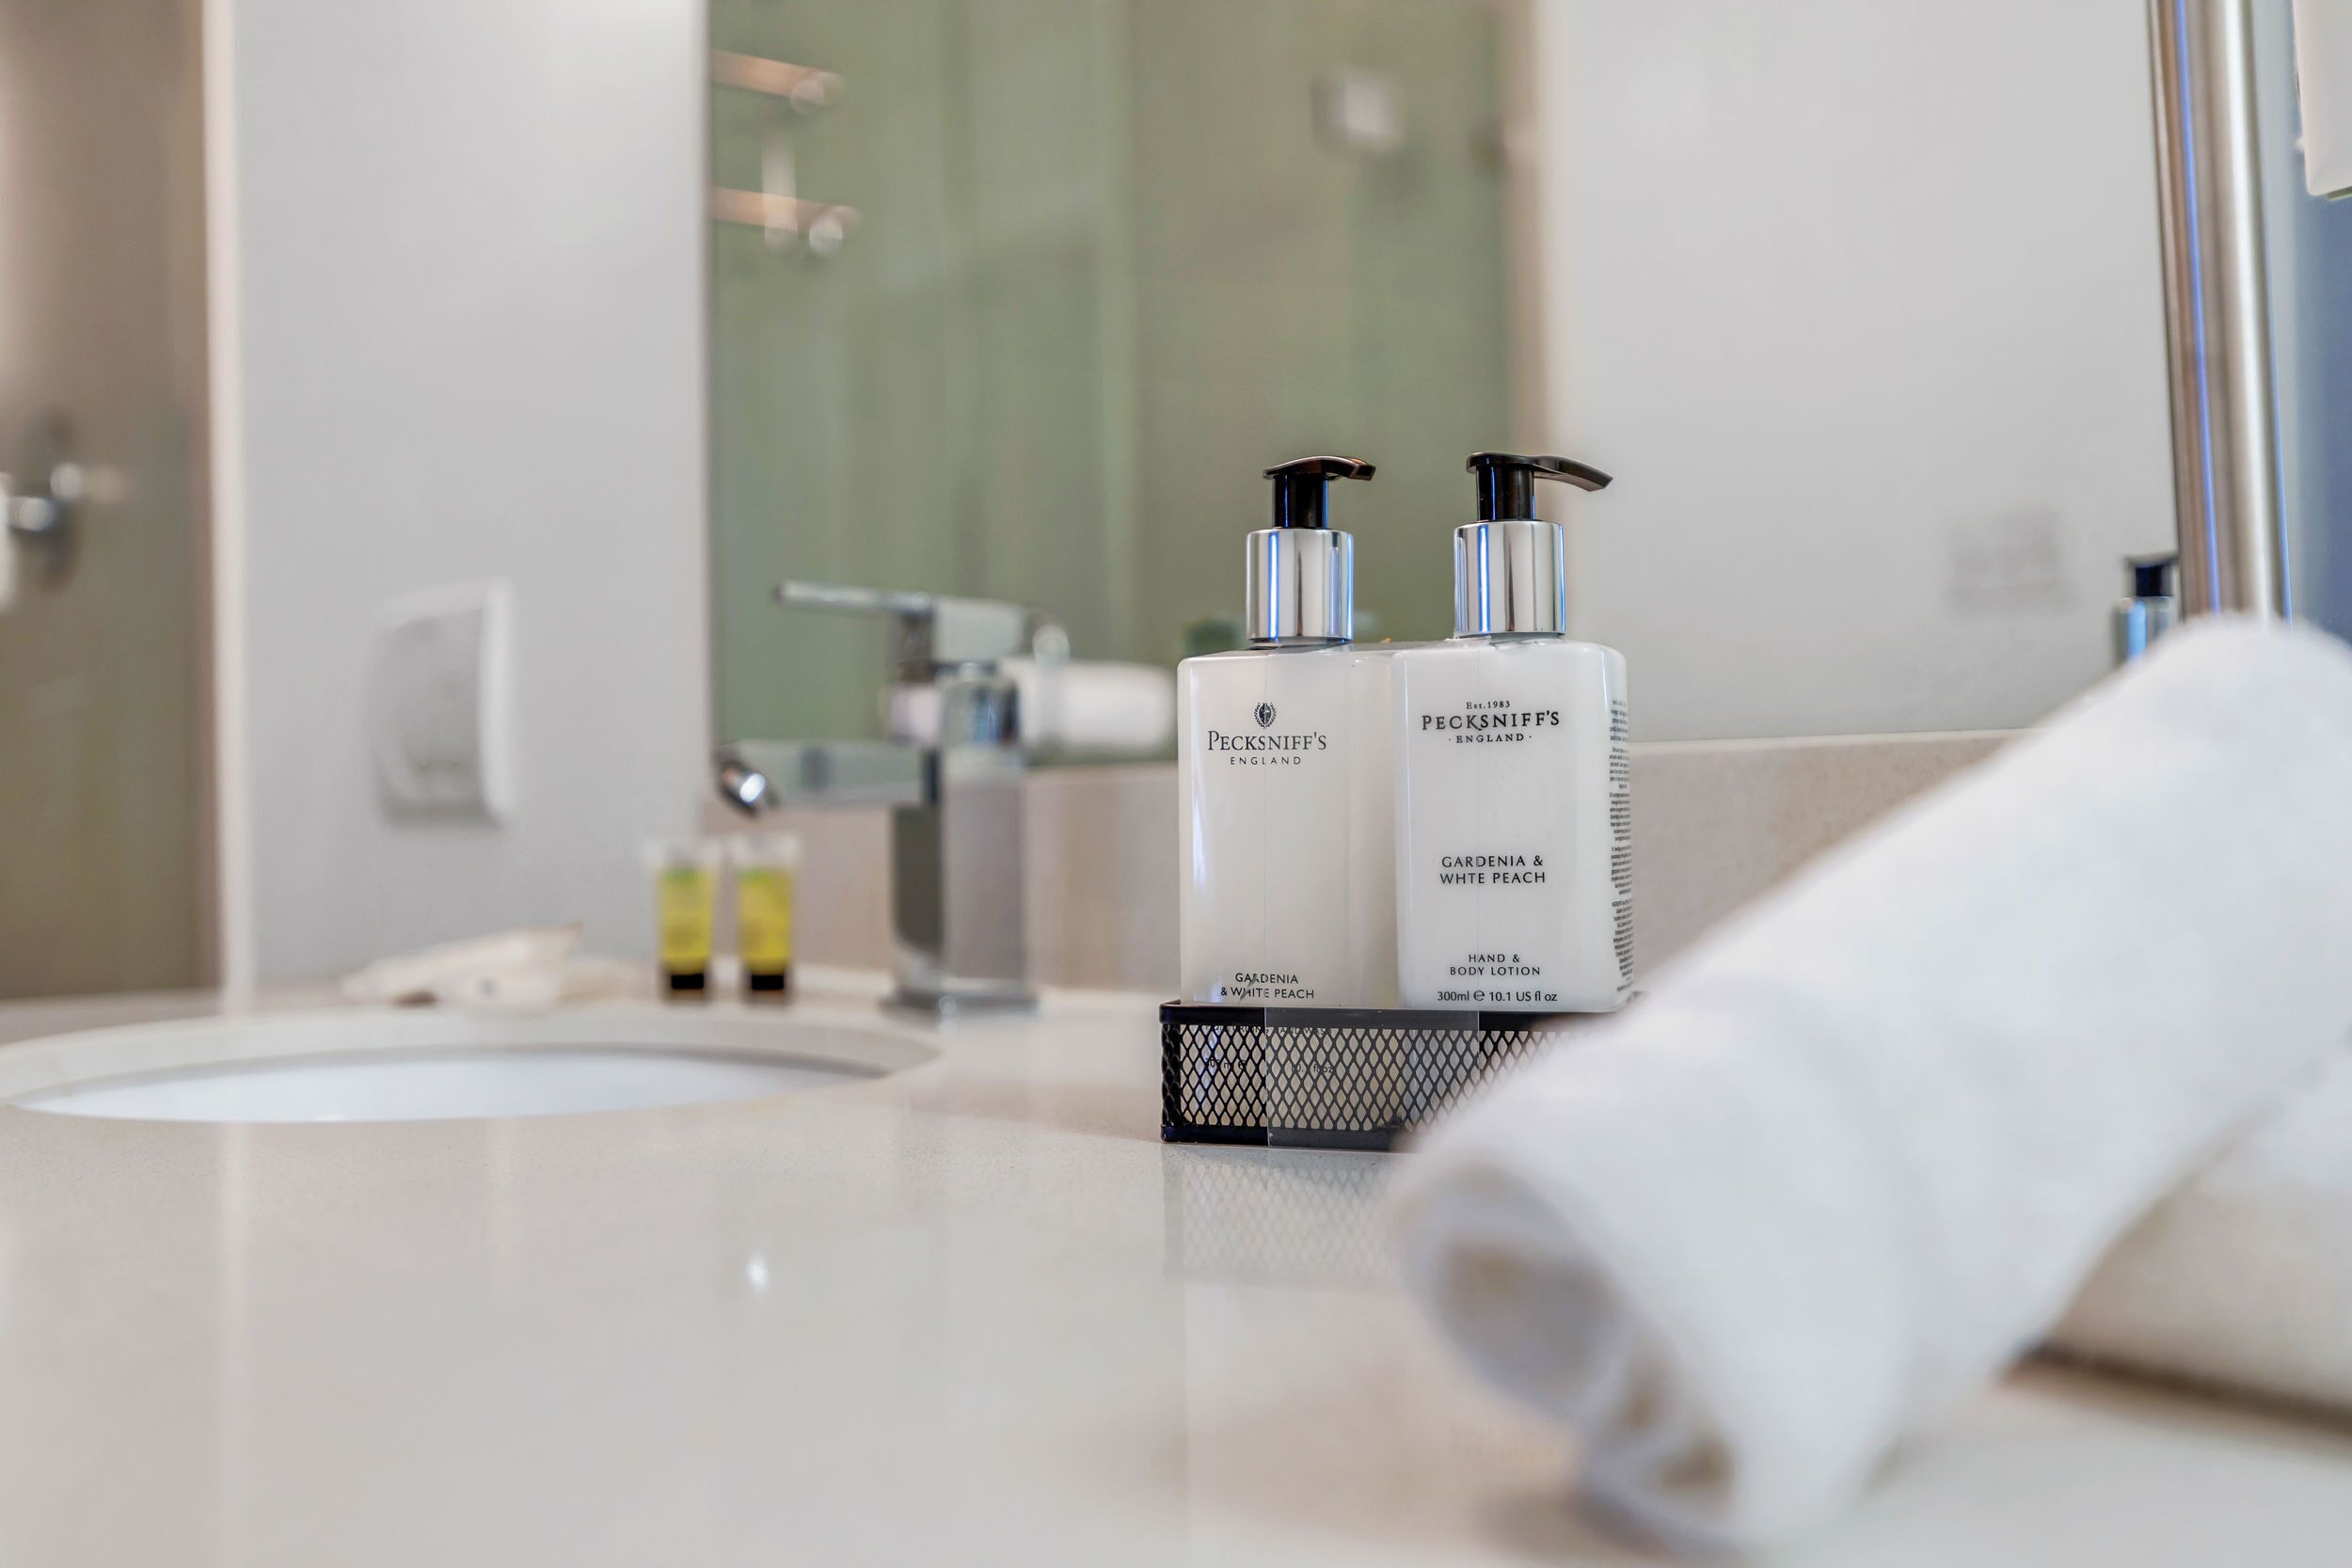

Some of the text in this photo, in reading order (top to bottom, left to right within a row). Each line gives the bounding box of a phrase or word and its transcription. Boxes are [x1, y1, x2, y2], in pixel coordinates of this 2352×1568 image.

[1466, 700, 1511, 710] Est.1983
[1422, 709, 1560, 731] PECKSNIFF'S
[1208, 730, 1327, 751] PECKSNIFF'S
[1455, 733, 1525, 744] ENGLAND
[1230, 756, 1301, 766] ENGLAND
[1441, 854, 1544, 868] GARDENIA &
[1492, 871, 1546, 884] PEACH
[1469, 953, 1520, 963] HAND &
[1450, 966, 1540, 976] BODY LOTION
[1220, 986, 1314, 999] & WHITE PEACH
[1438, 990, 1470, 1002] 300ml
[1488, 990, 1511, 1002] 10.1
[1516, 990, 1532, 1002] US
[1534, 990, 1541, 1002] fl
[1544, 993, 1558, 1002] oz
